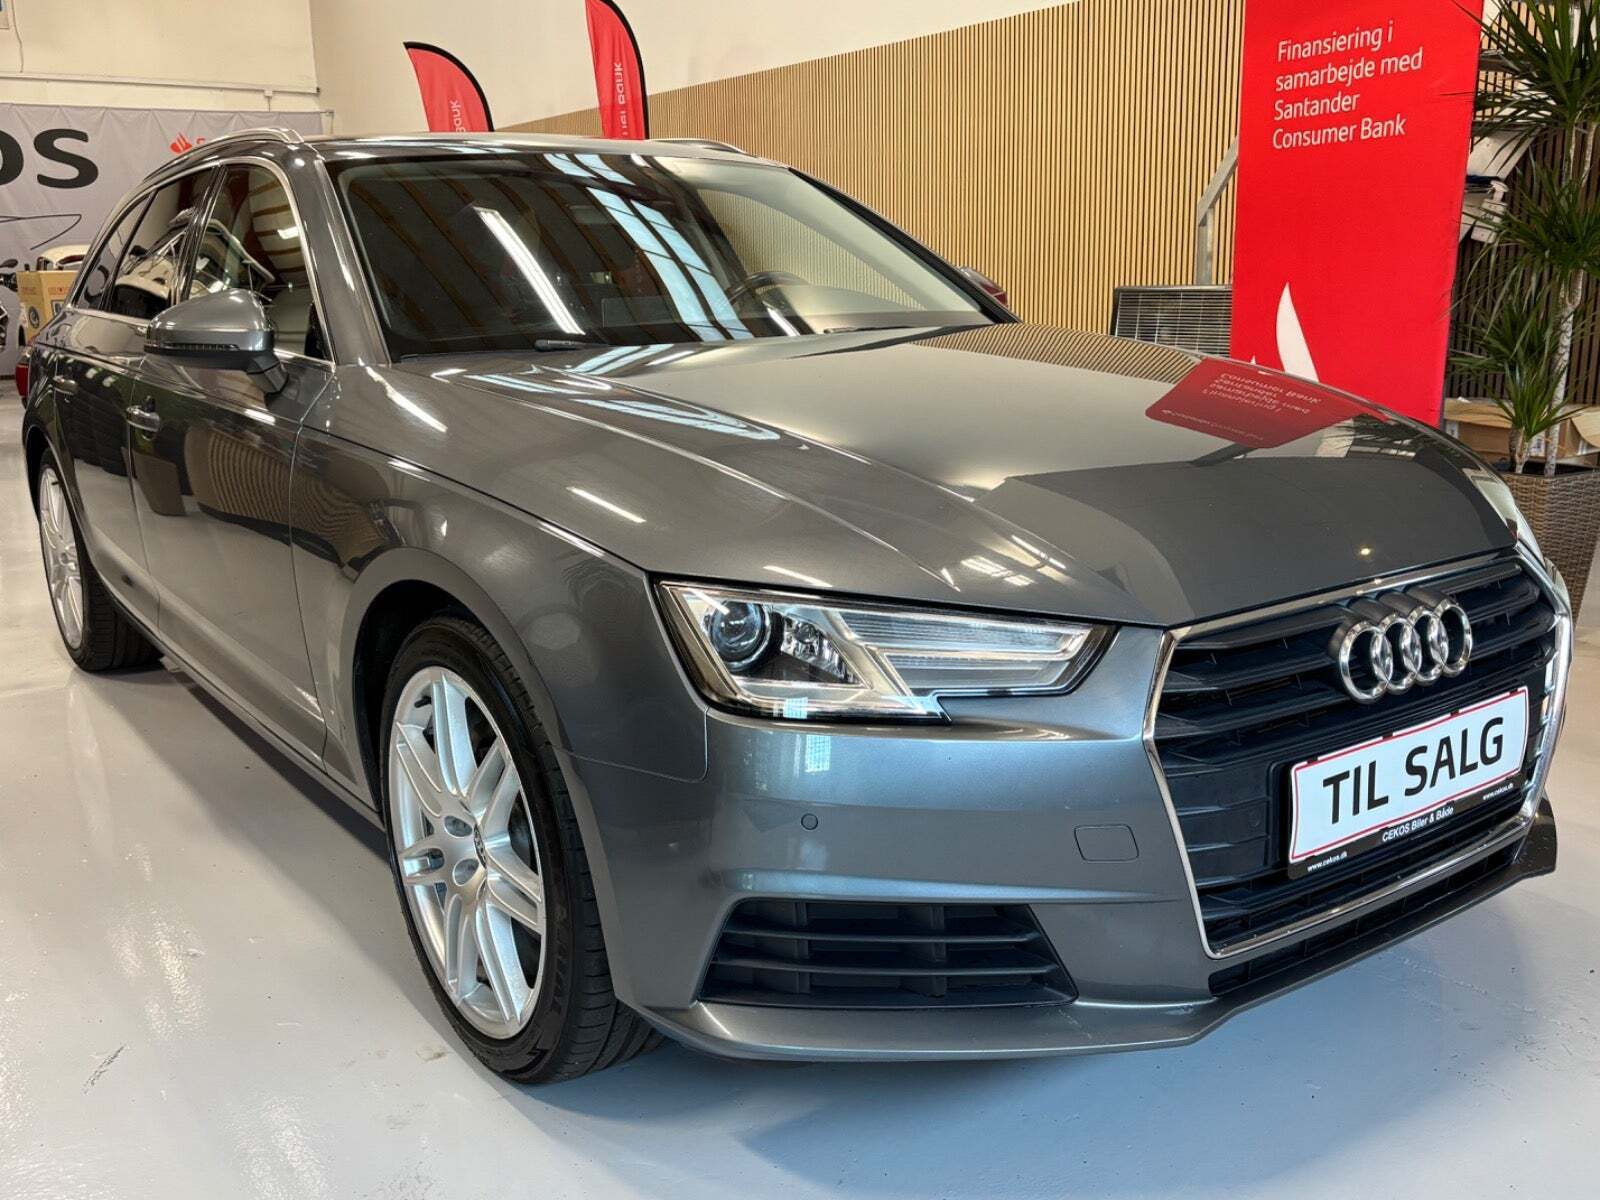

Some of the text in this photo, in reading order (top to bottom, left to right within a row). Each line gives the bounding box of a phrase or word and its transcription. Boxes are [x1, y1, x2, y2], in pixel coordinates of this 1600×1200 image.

[1277, 20, 1393, 62] Finansiering i
[1275, 47, 1423, 92] samarbejde med
[1274, 90, 1360, 121] Santander
[1272, 114, 1406, 149] Consumer Bank
[1322, 716, 1505, 825] TIL SALG
[1382, 806, 1454, 842] CEKOS Biler & Både
